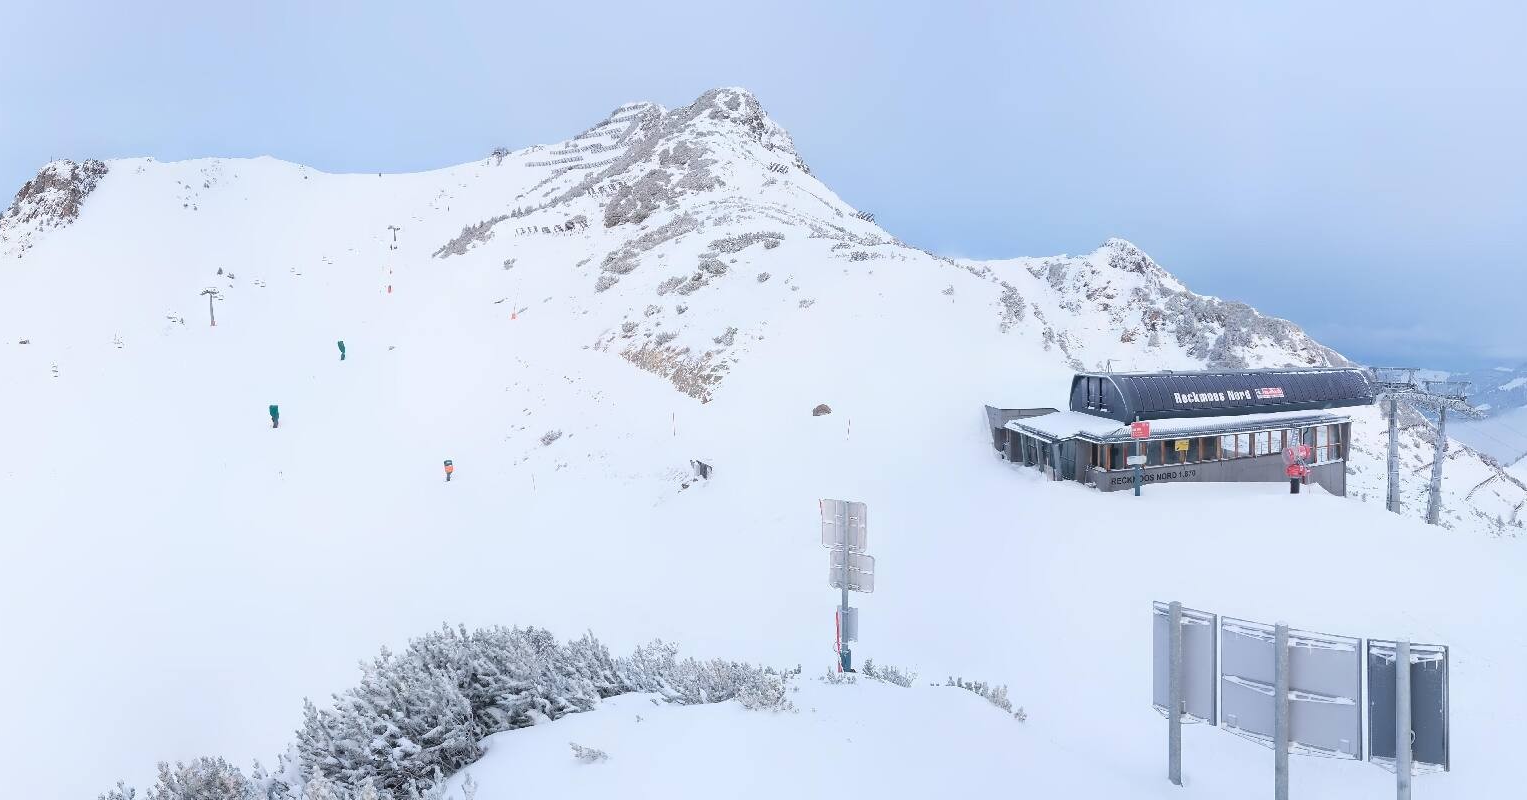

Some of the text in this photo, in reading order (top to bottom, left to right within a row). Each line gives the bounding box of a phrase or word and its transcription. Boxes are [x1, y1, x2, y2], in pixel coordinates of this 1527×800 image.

[1227, 389, 1252, 401] Nord
[1111, 474, 1155, 485] RECKOOS
[1156, 471, 1178, 481] NORD
